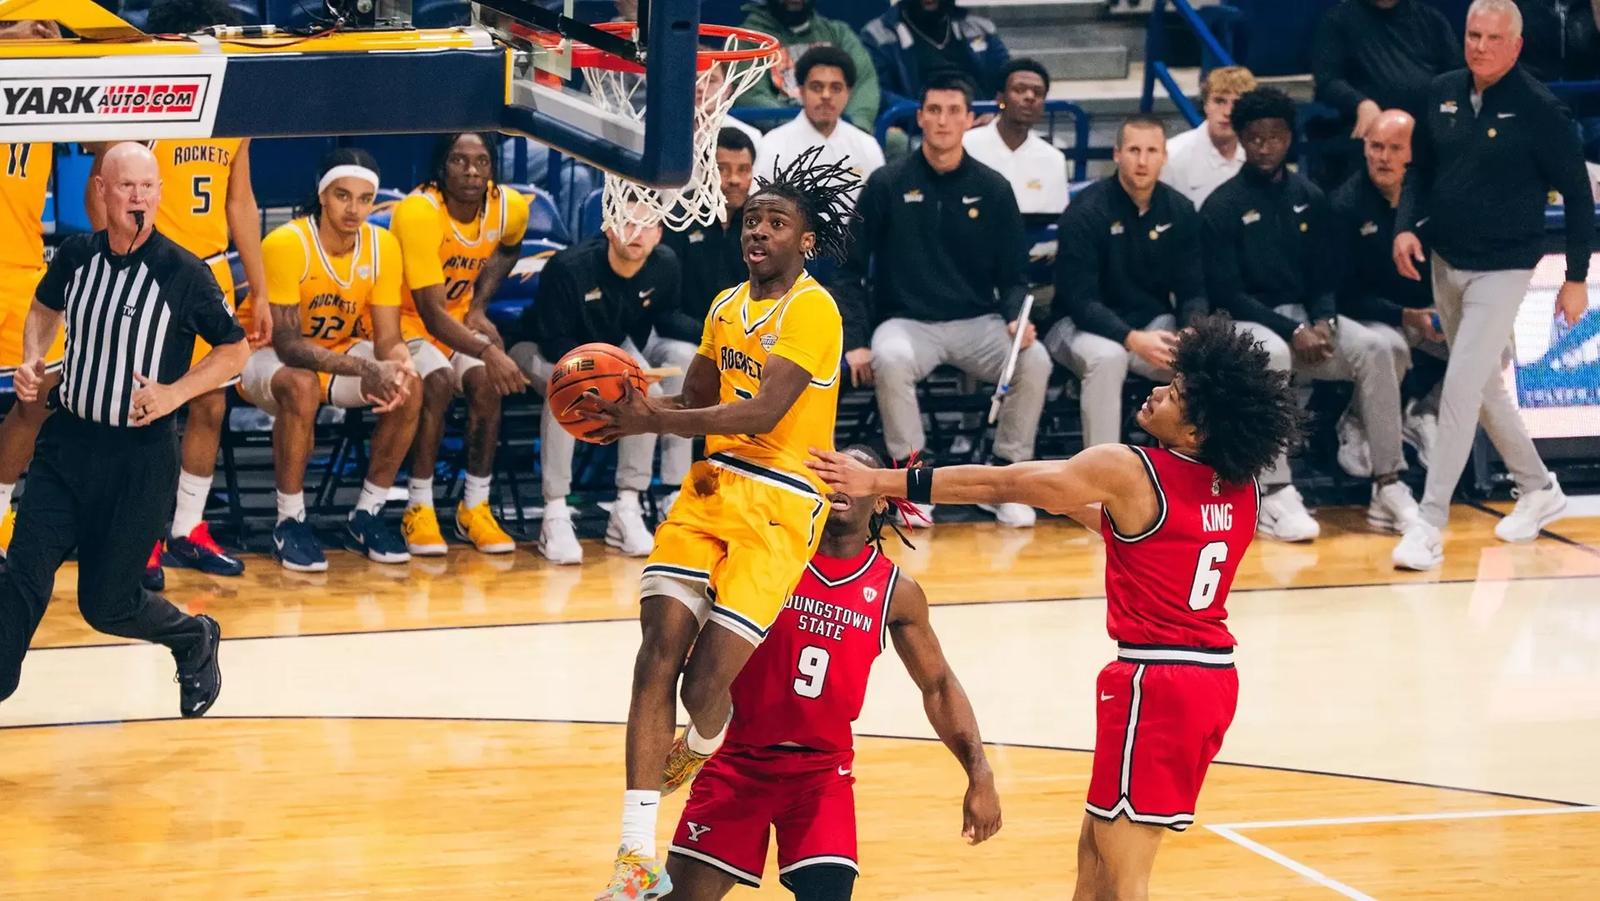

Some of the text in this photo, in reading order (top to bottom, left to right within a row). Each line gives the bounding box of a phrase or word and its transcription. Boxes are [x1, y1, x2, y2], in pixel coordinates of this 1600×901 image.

[3, 86, 192, 115] YARK AUTO.COM
[174, 145, 230, 166] ROCKETS
[192, 176, 211, 214] 5
[123, 305, 136, 316] TW
[308, 293, 357, 314] ROCKETS
[302, 316, 345, 339] 32
[720, 345, 763, 381] ROCKET
[1200, 503, 1233, 532] KING
[1187, 541, 1229, 611] 6
[784, 595, 873, 632] OUNGSTOWN
[798, 615, 845, 641] STATE
[793, 644, 831, 699] 9
[687, 821, 711, 842] Y
